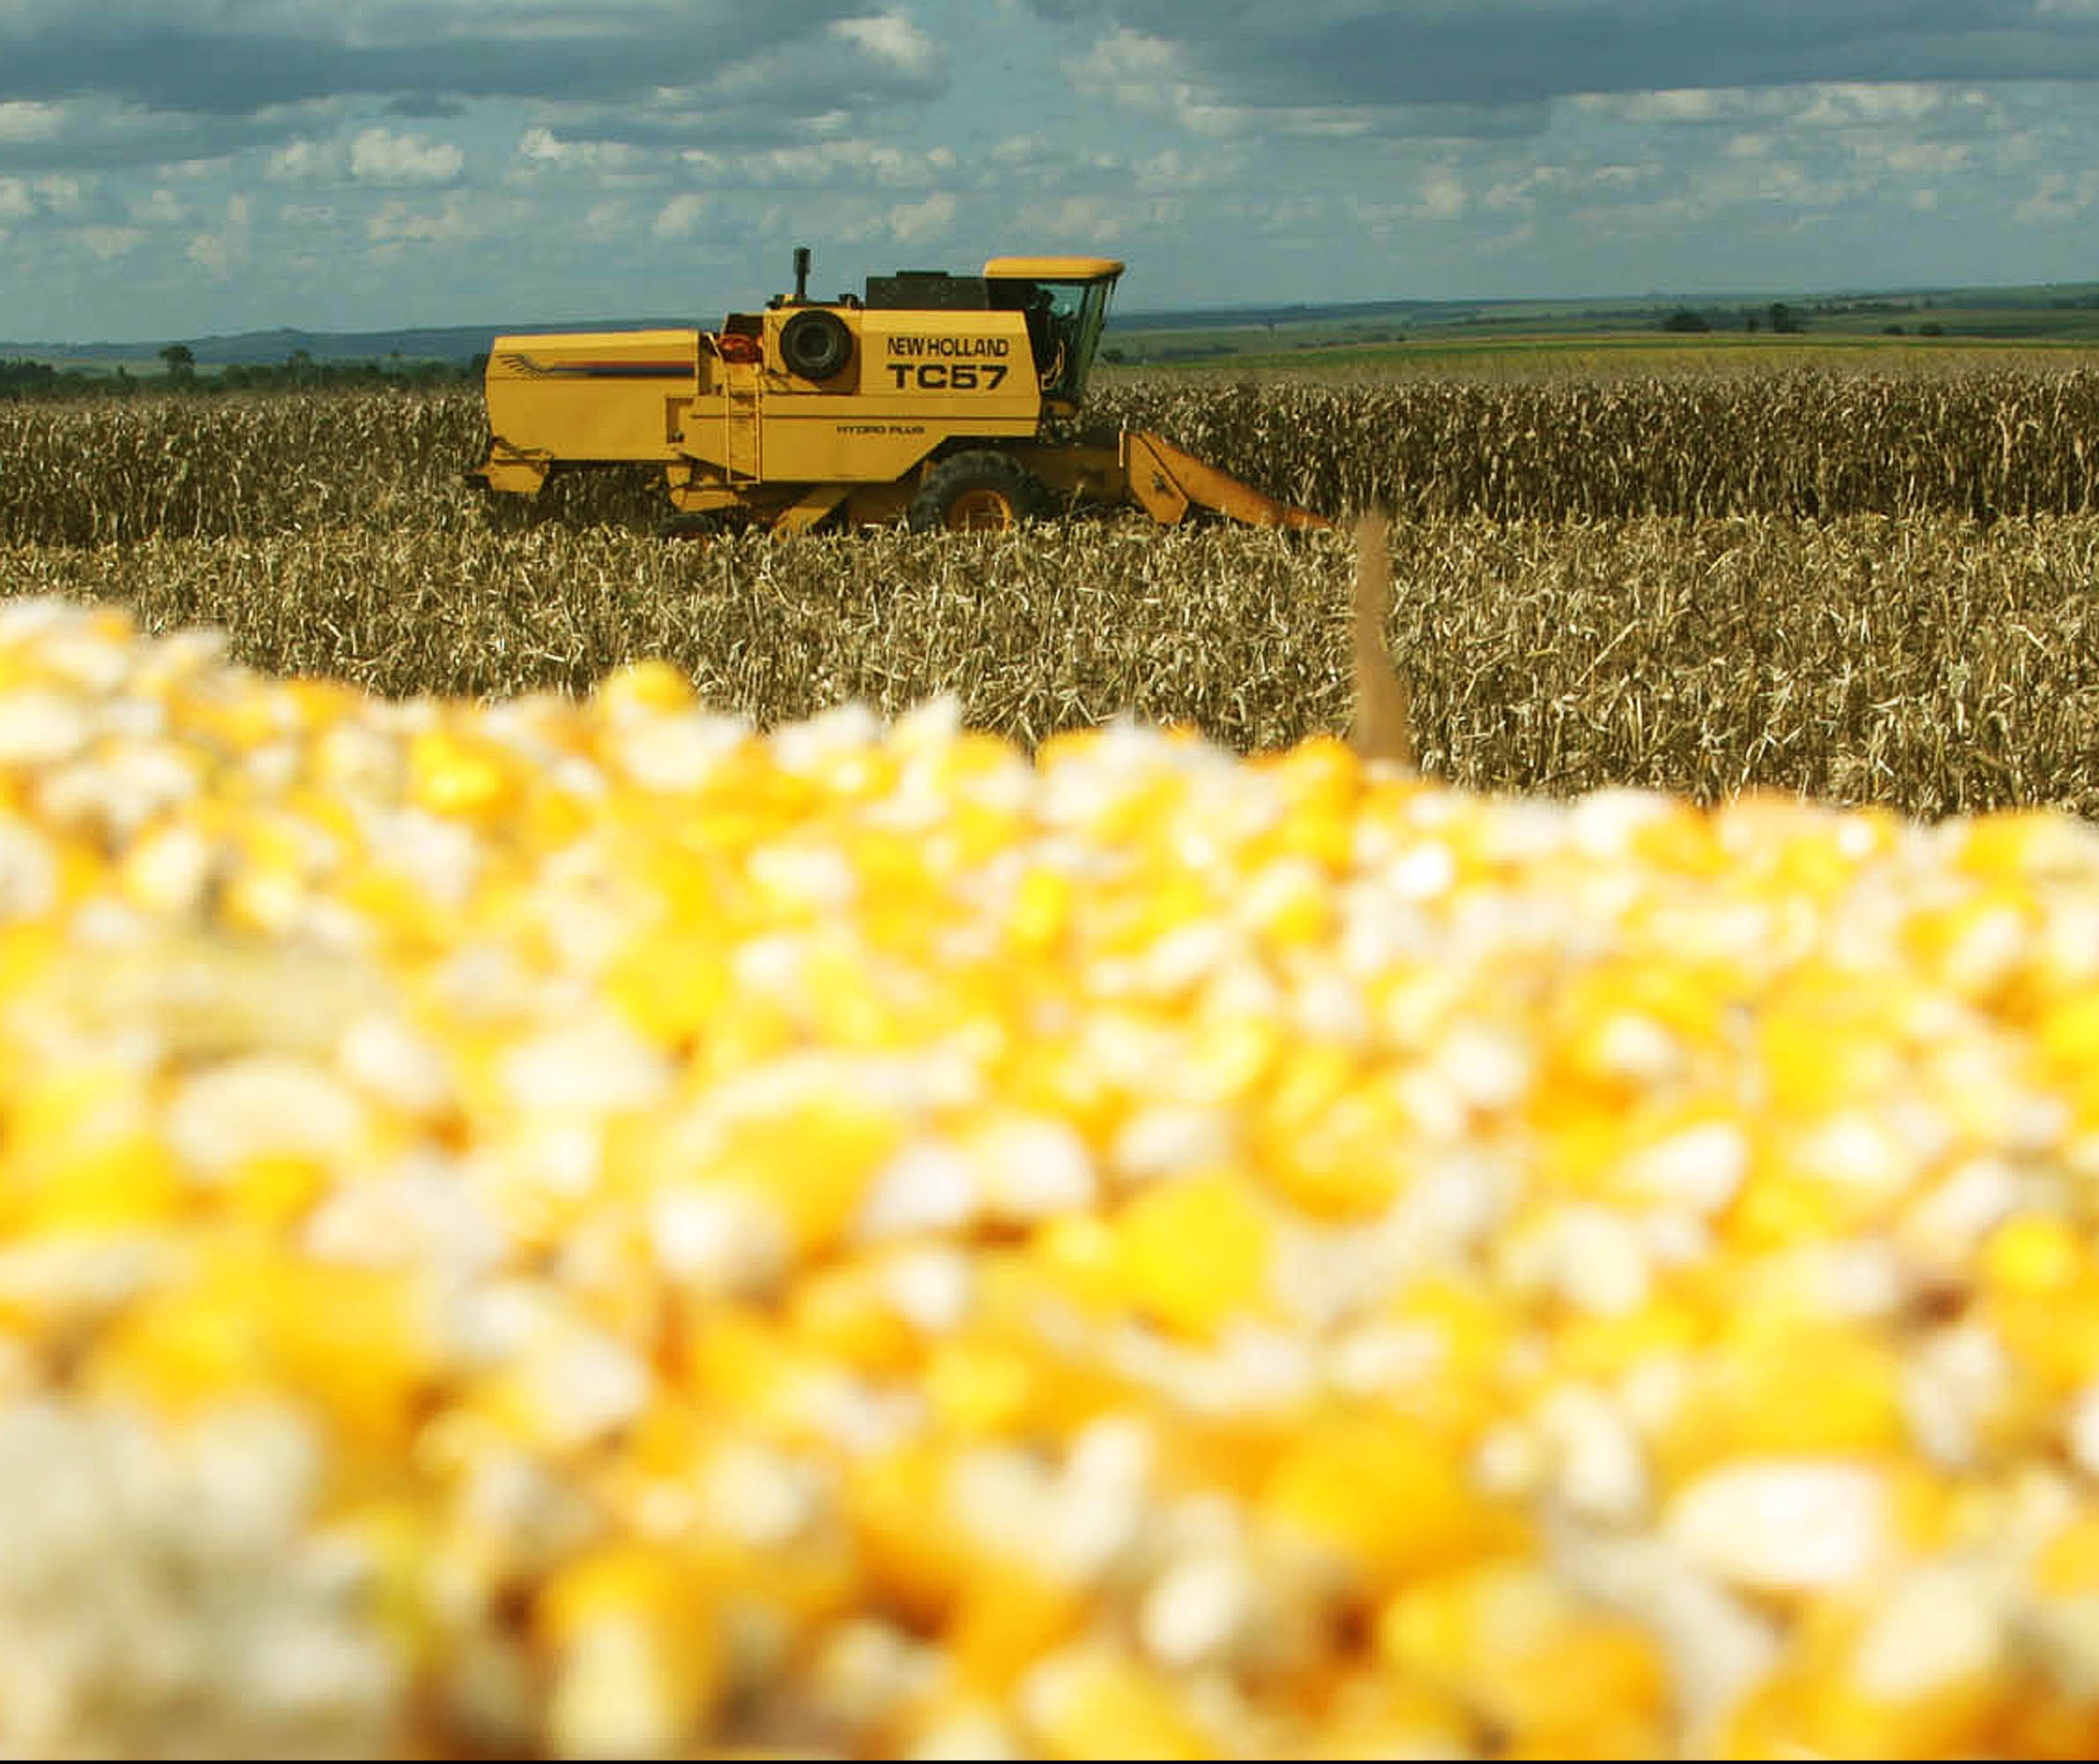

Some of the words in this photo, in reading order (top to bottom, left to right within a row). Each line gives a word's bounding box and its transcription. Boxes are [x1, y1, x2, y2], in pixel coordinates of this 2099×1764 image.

[888, 338, 923, 356] NEW
[928, 338, 1009, 356] HOLLAND
[887, 364, 1009, 389] TC57
[837, 425, 885, 434] HYDRO
[889, 425, 925, 434] PLUS
